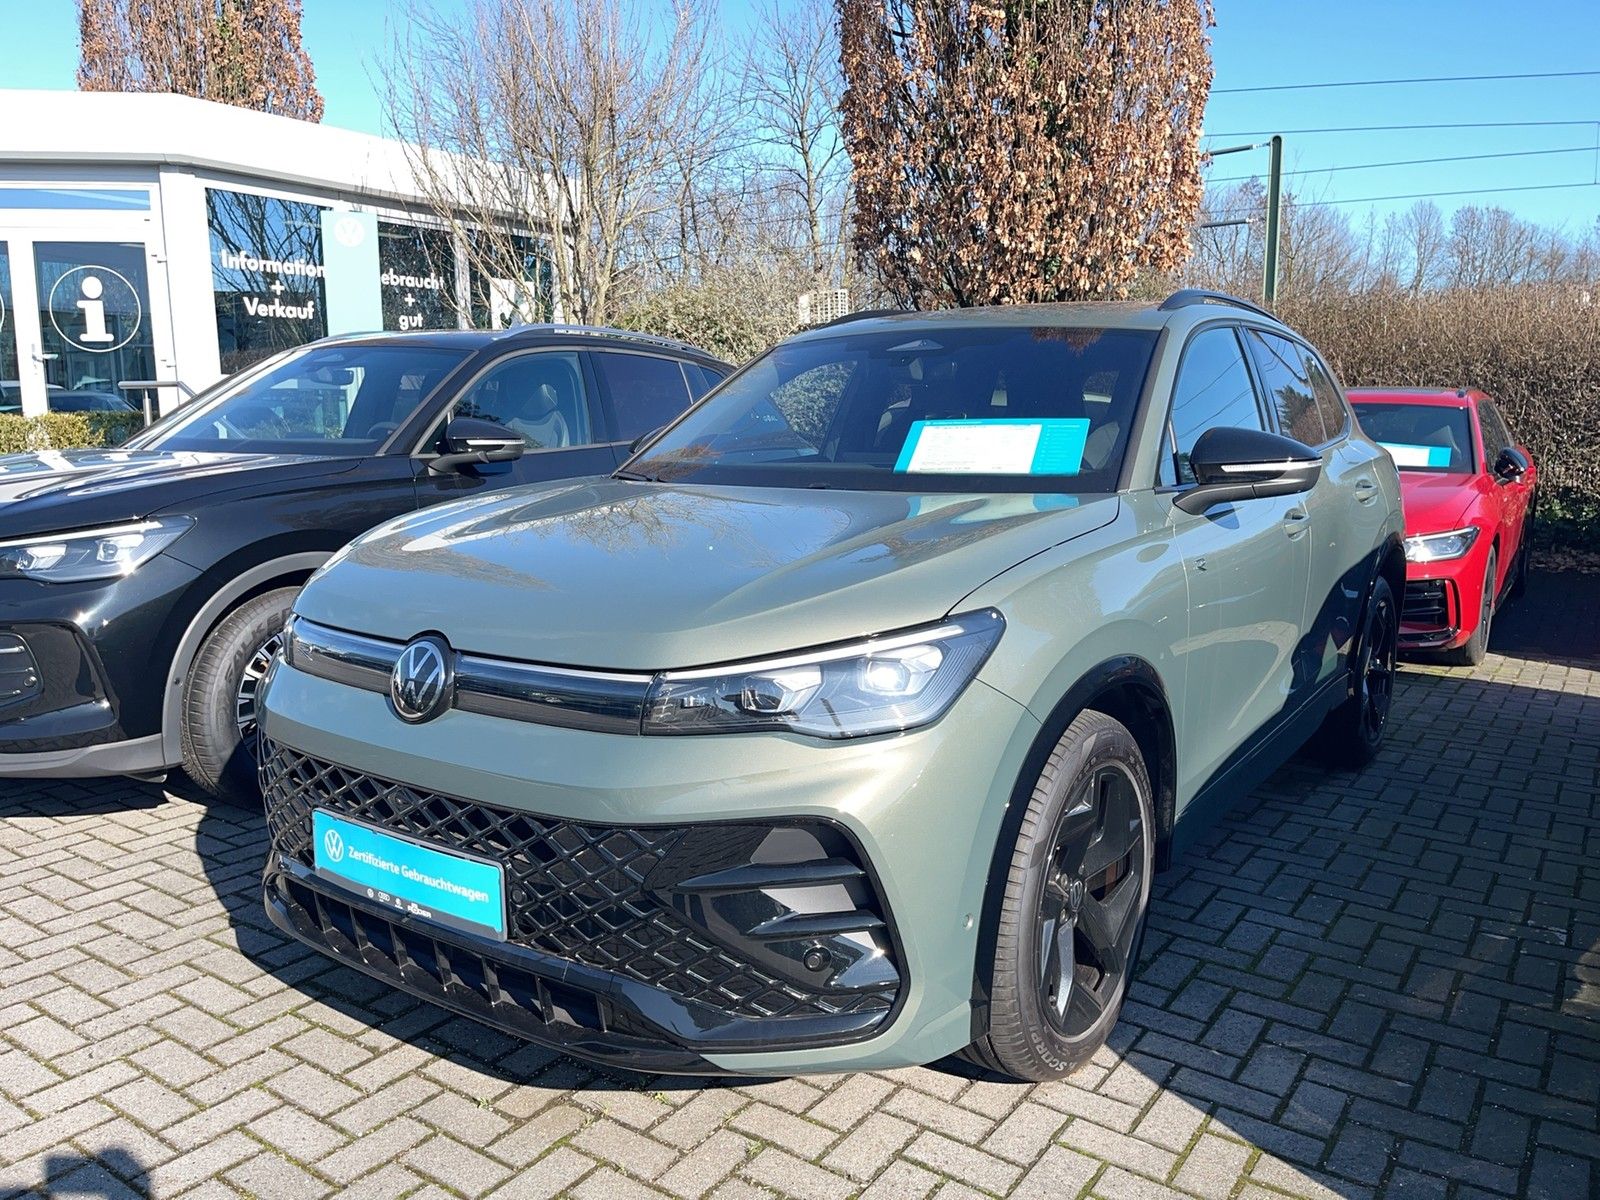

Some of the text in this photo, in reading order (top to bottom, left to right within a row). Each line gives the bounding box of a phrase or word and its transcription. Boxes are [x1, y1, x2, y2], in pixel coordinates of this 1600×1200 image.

[221, 249, 325, 277] Information
[381, 267, 445, 290] ebraucht
[242, 296, 315, 320] Verkauf
[398, 313, 424, 331] gut
[348, 845, 489, 903] Zertifizierte Gebrauchtwagen
[1027, 1013, 1068, 1071] SCORPI
